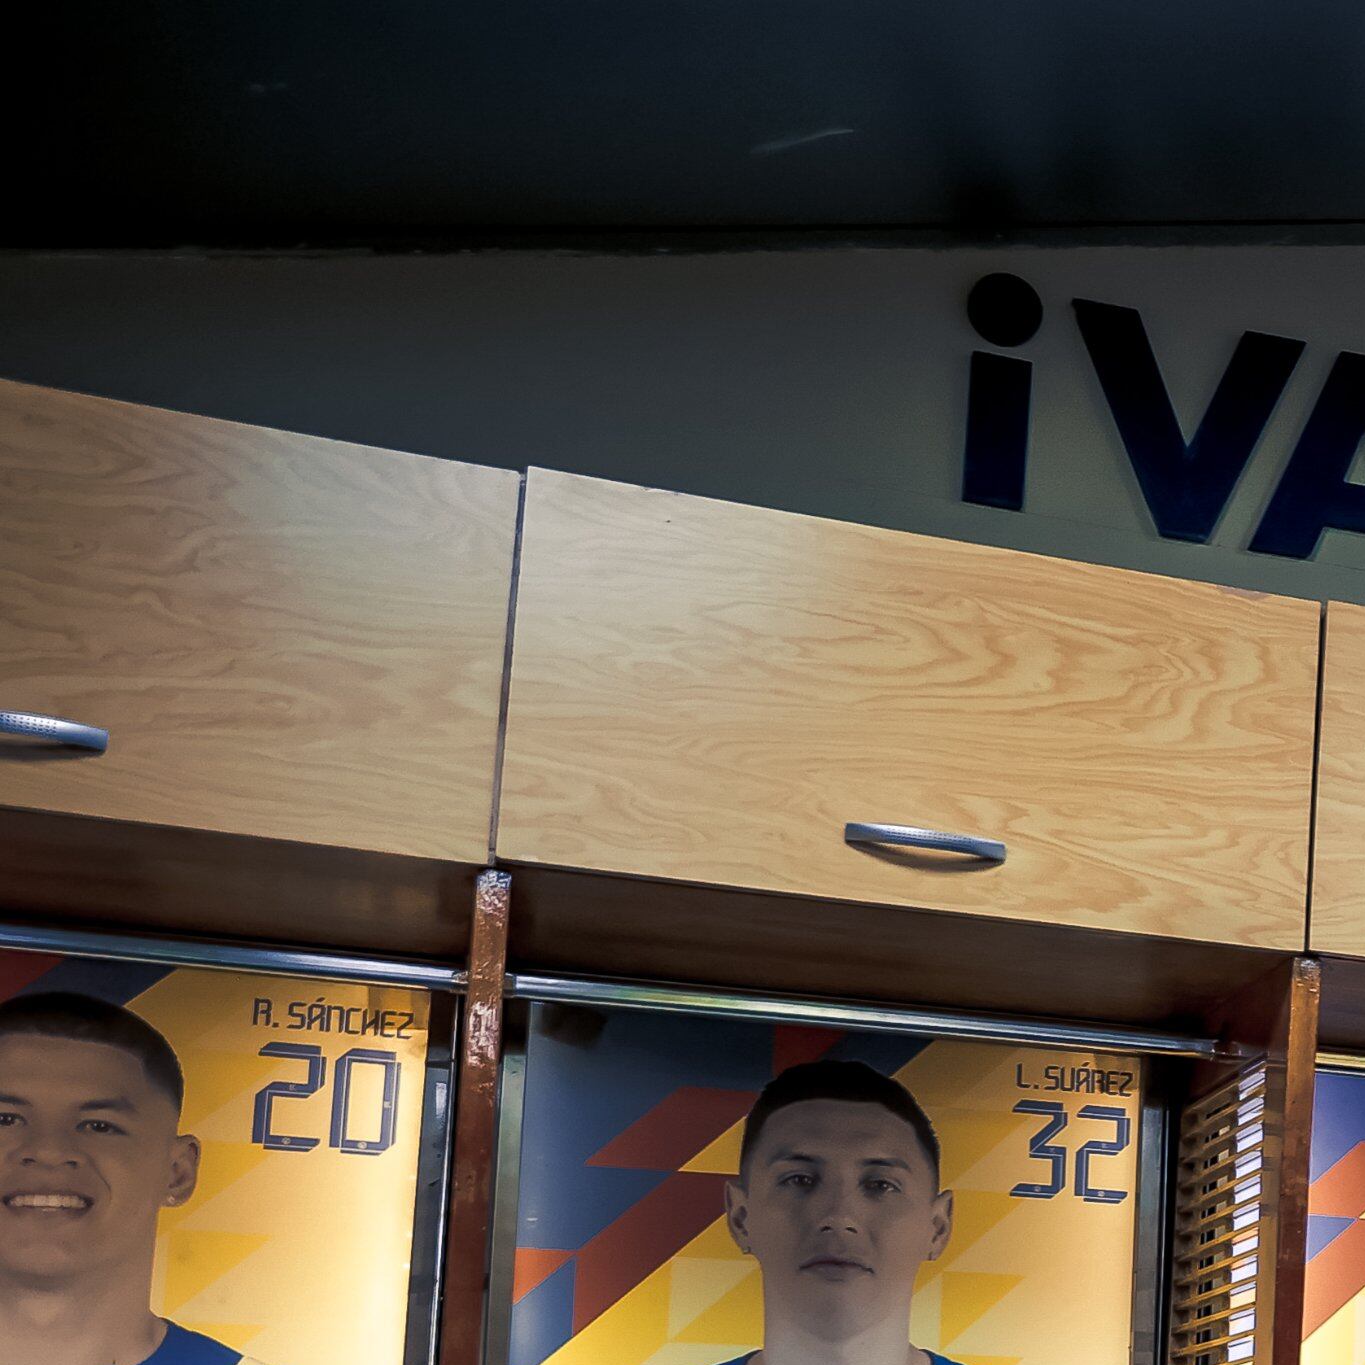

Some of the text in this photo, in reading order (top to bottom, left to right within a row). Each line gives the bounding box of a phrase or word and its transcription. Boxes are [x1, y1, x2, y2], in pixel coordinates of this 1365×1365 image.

[286, 996, 415, 1040] SÁNCHEZ
[251, 1041, 402, 1157] 20
[1015, 1061, 1134, 1098] L. SUÁREZ
[1008, 1098, 1131, 1205] 32
